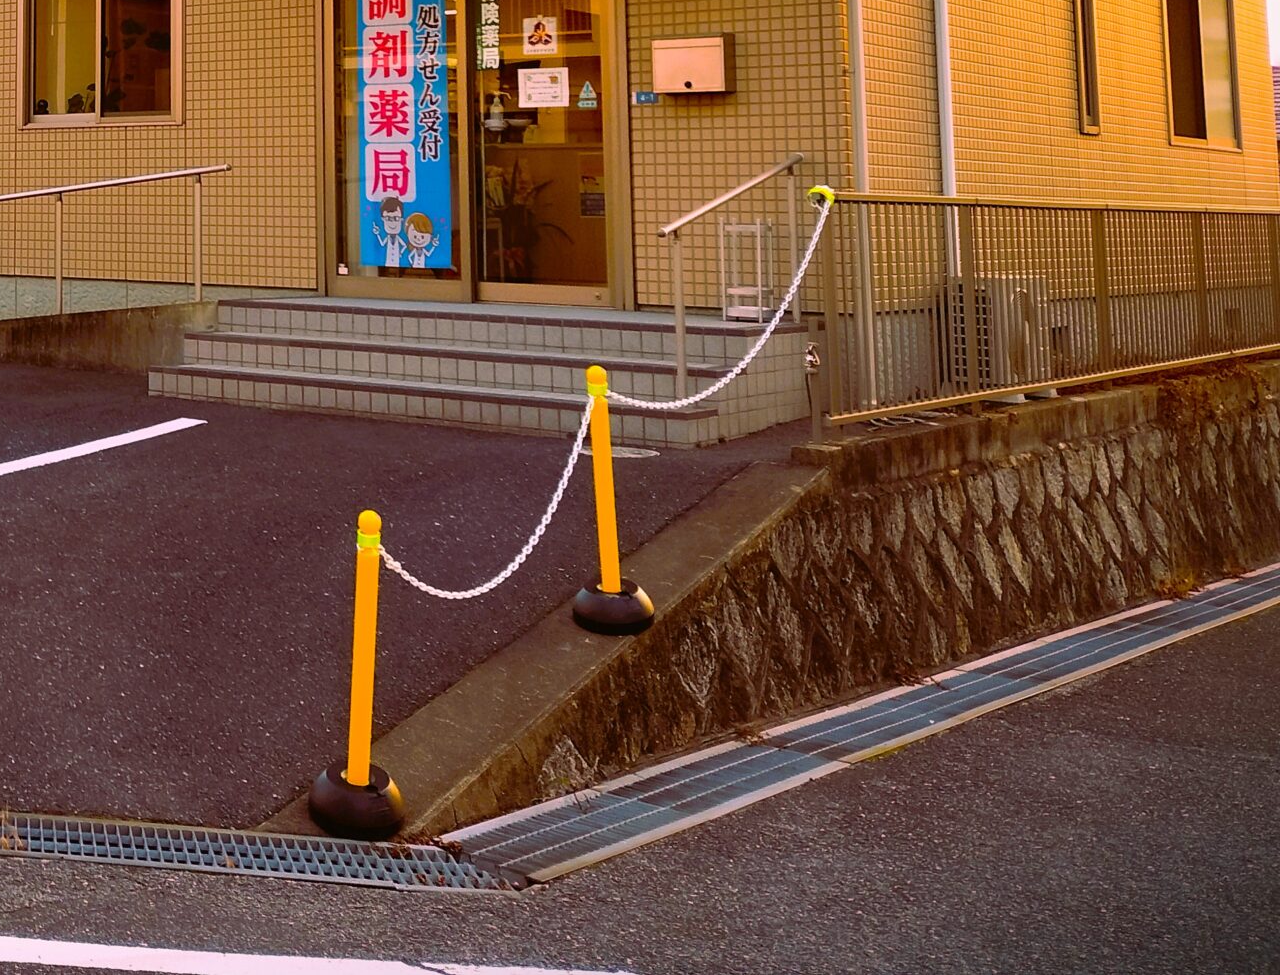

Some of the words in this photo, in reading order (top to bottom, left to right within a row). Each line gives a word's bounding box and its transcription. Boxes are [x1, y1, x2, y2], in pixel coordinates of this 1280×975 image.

[417, 4, 442, 162] 処方せん受付
